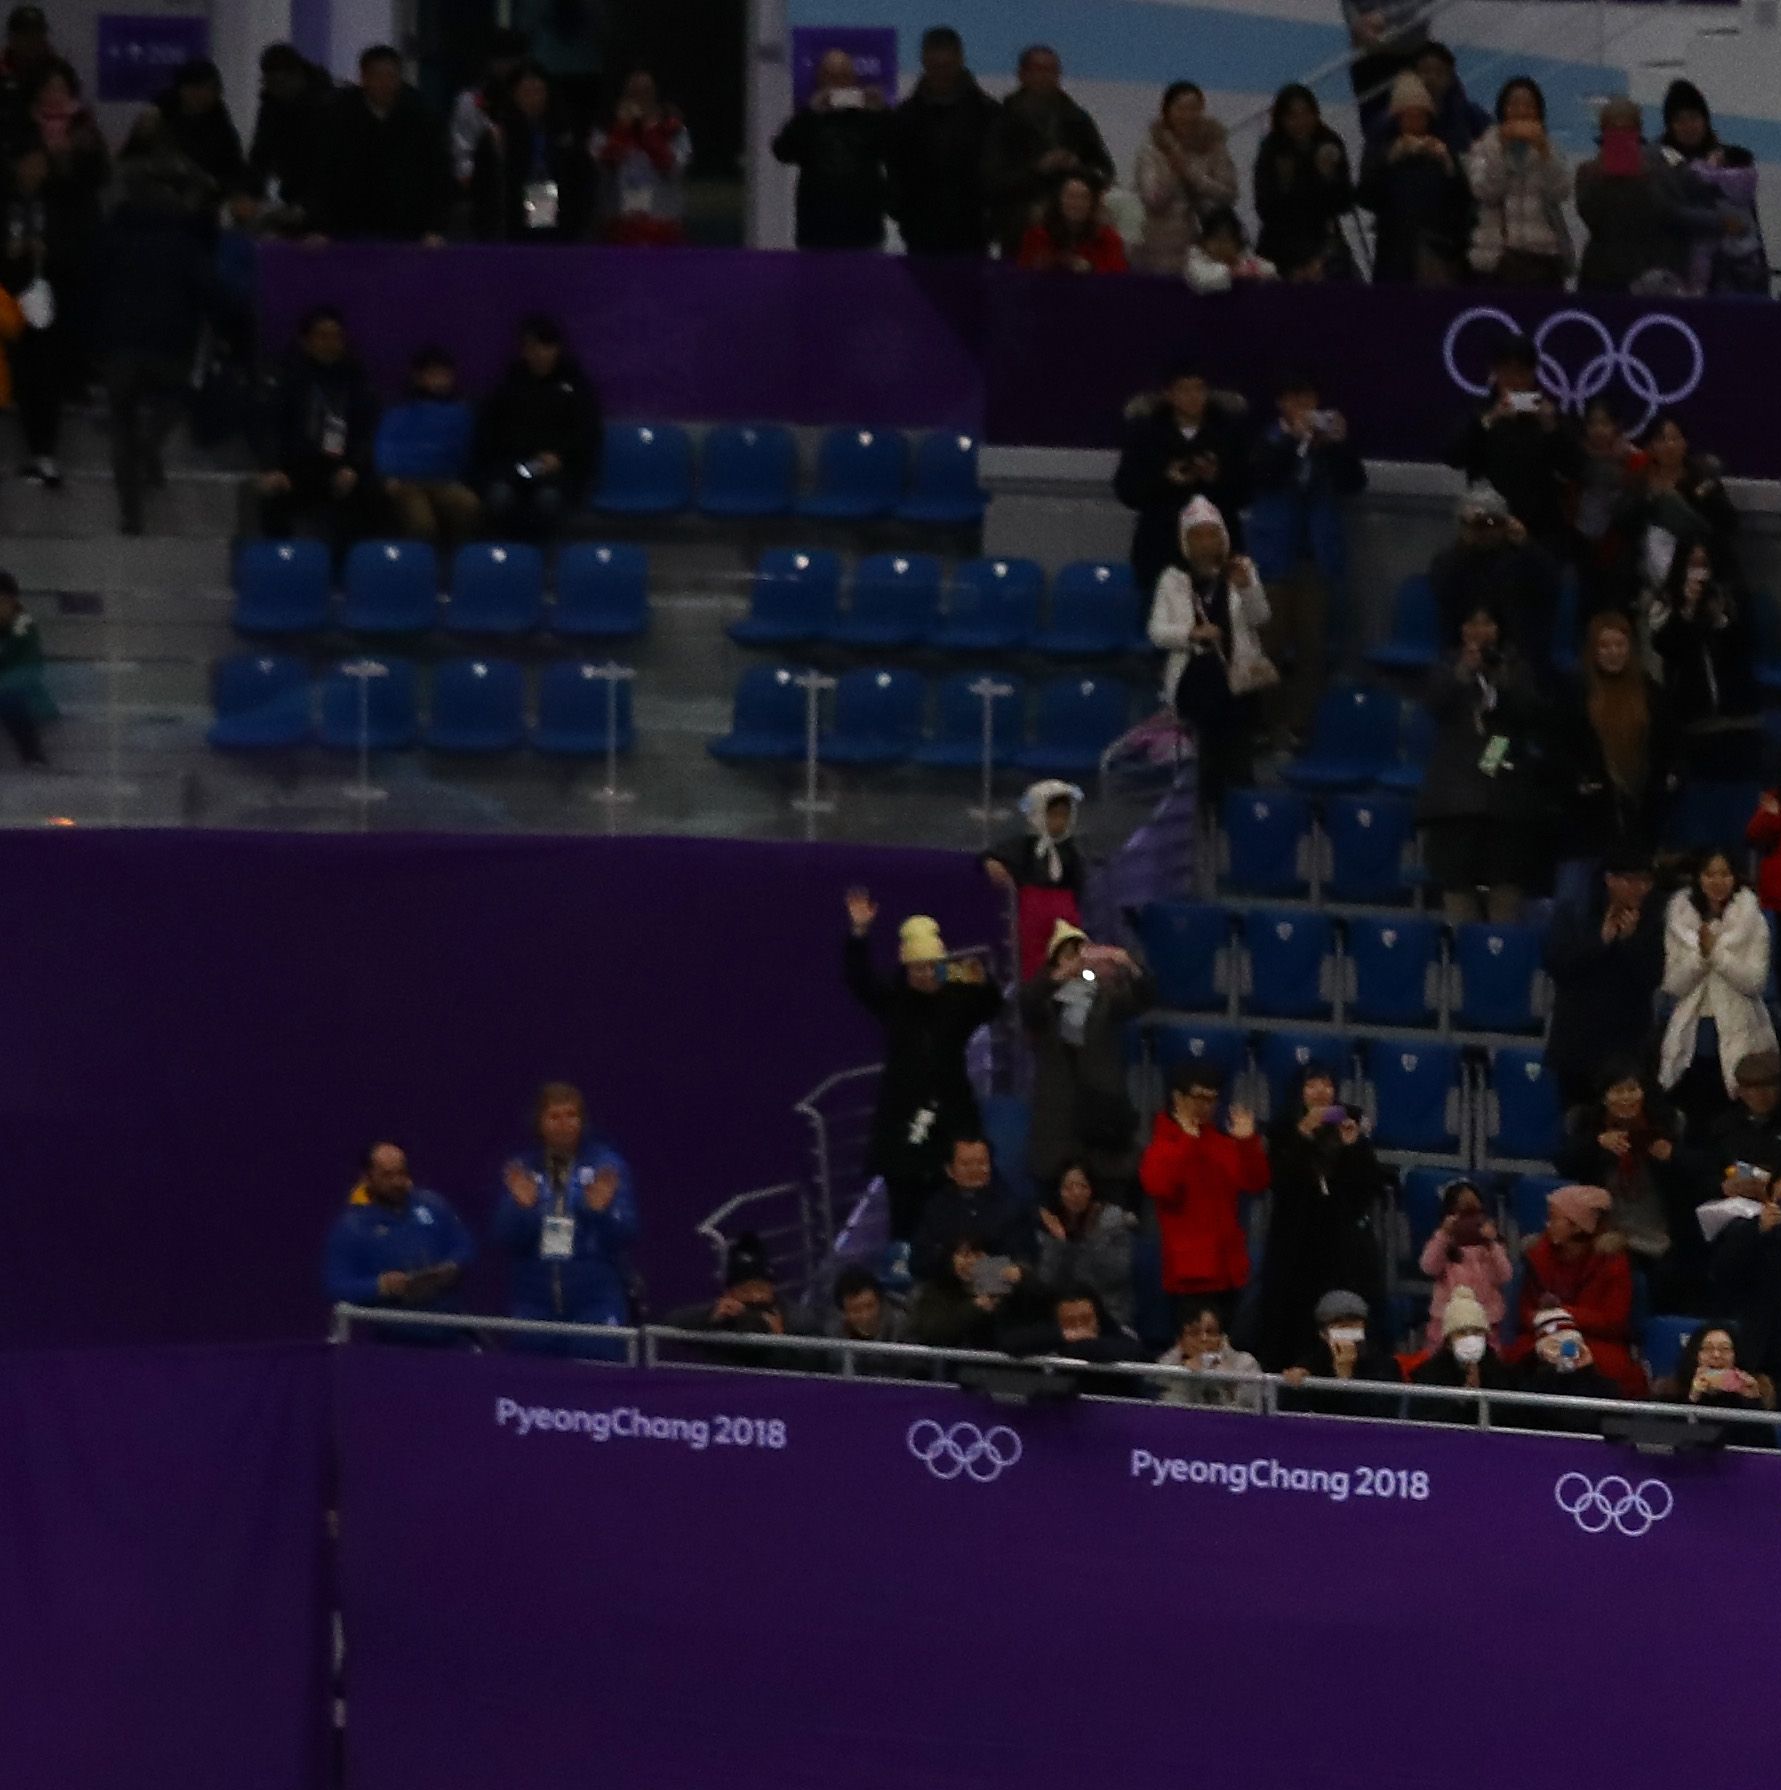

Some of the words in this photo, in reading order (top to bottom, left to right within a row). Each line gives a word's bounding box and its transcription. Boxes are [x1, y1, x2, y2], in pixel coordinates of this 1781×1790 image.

[496, 1397, 710, 1450] PyeongChang
[713, 1414, 787, 1449] 2018
[1131, 1449, 1350, 1502] PyeongChang
[1354, 1466, 1430, 1501] 2018
